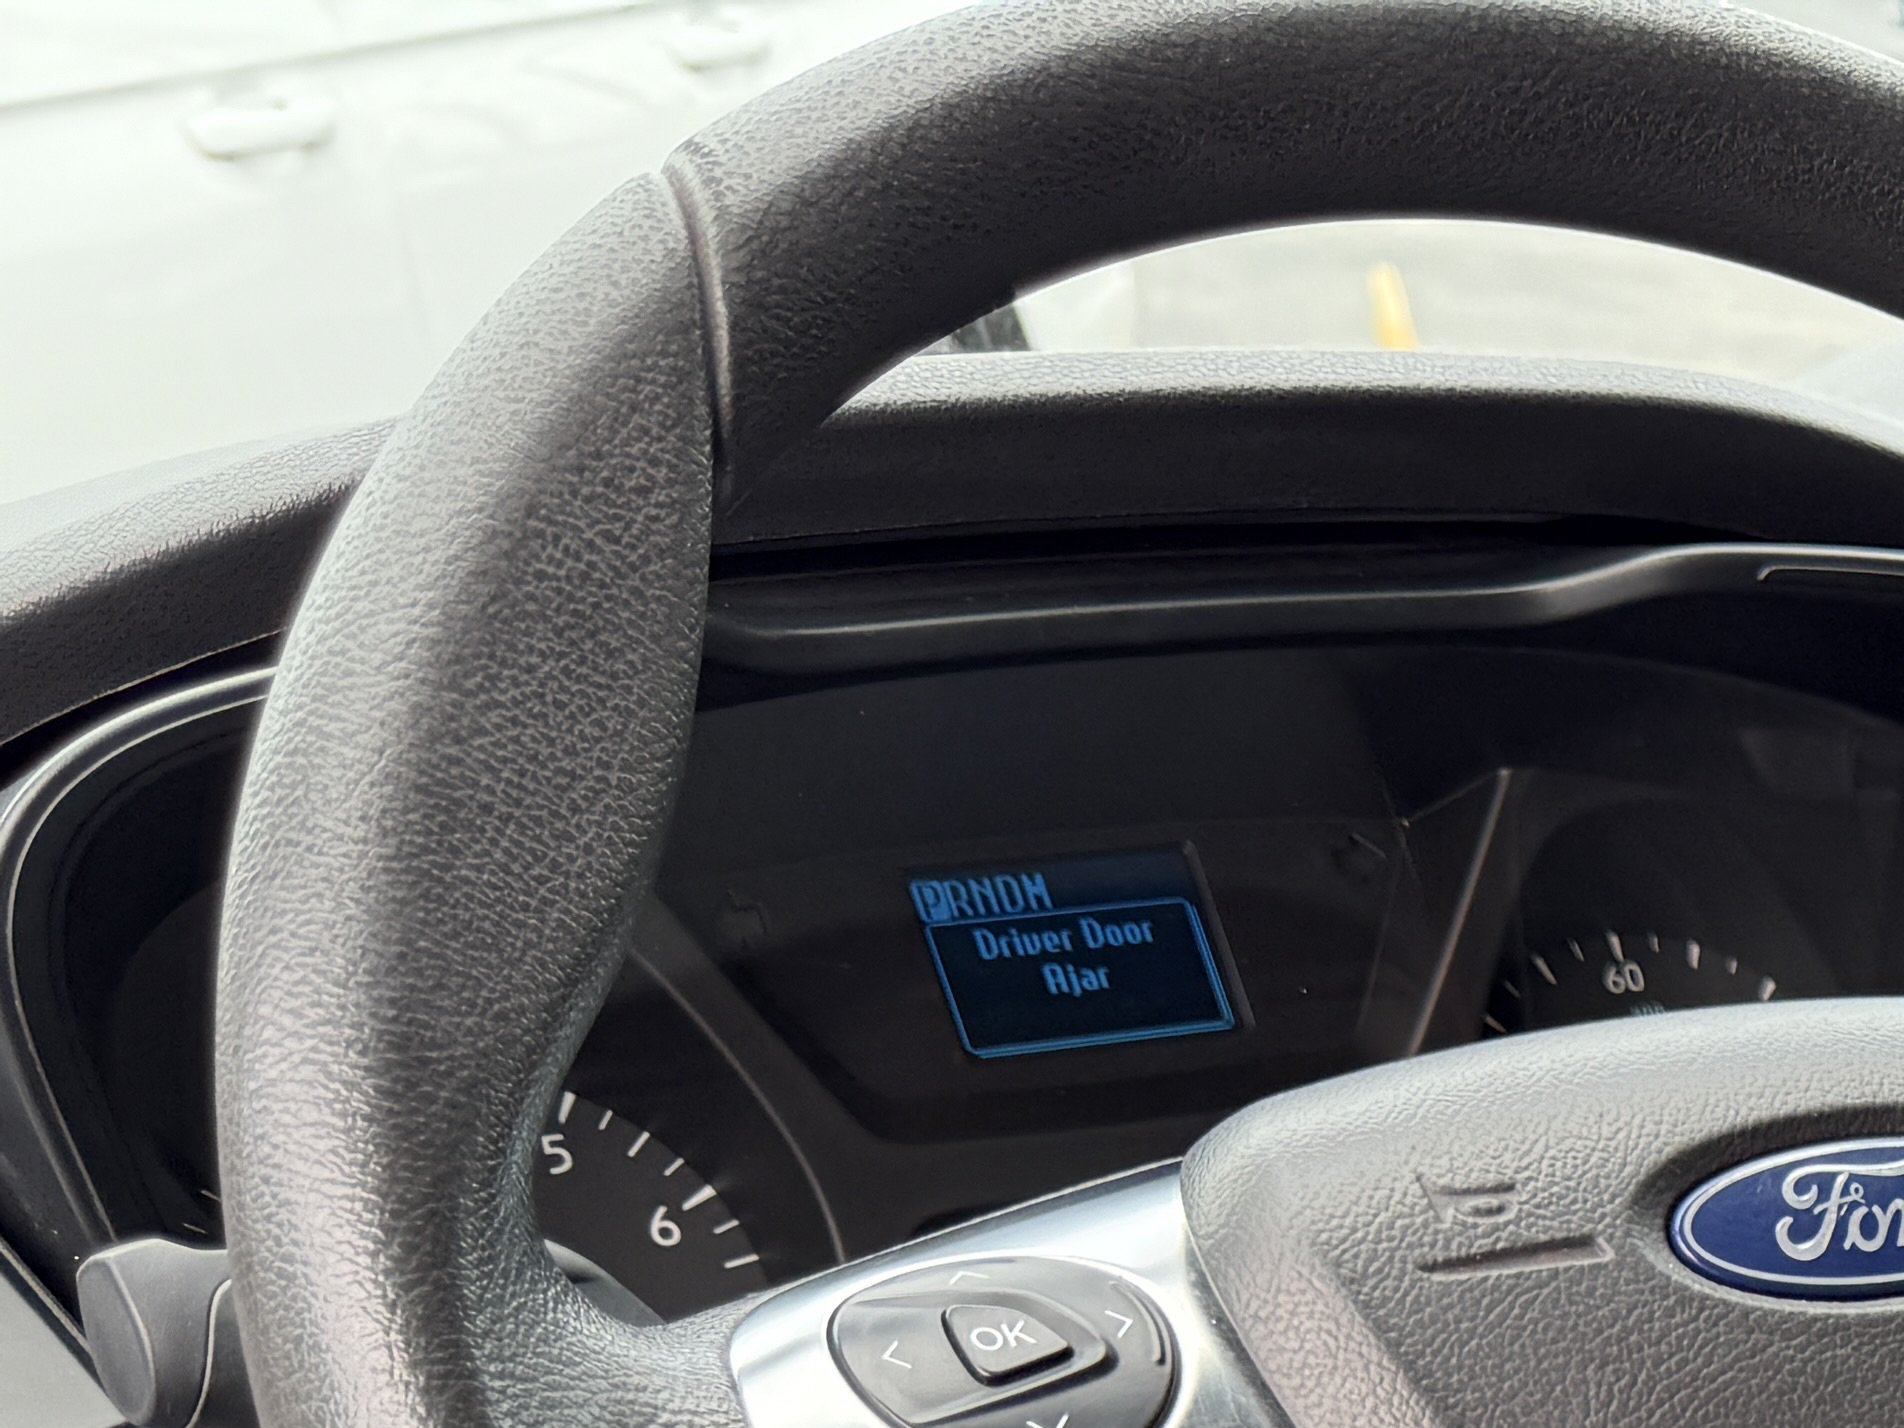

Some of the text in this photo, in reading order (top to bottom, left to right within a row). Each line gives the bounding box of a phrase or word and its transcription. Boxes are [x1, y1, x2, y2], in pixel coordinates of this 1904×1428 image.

[972, 916, 1154, 961] Driver Door
[1041, 961, 1110, 997] Ajar
[1602, 959, 1645, 994] 60
[541, 1133, 573, 1175] 5
[650, 1205, 682, 1247] 6
[970, 1319, 1038, 1351] OK
